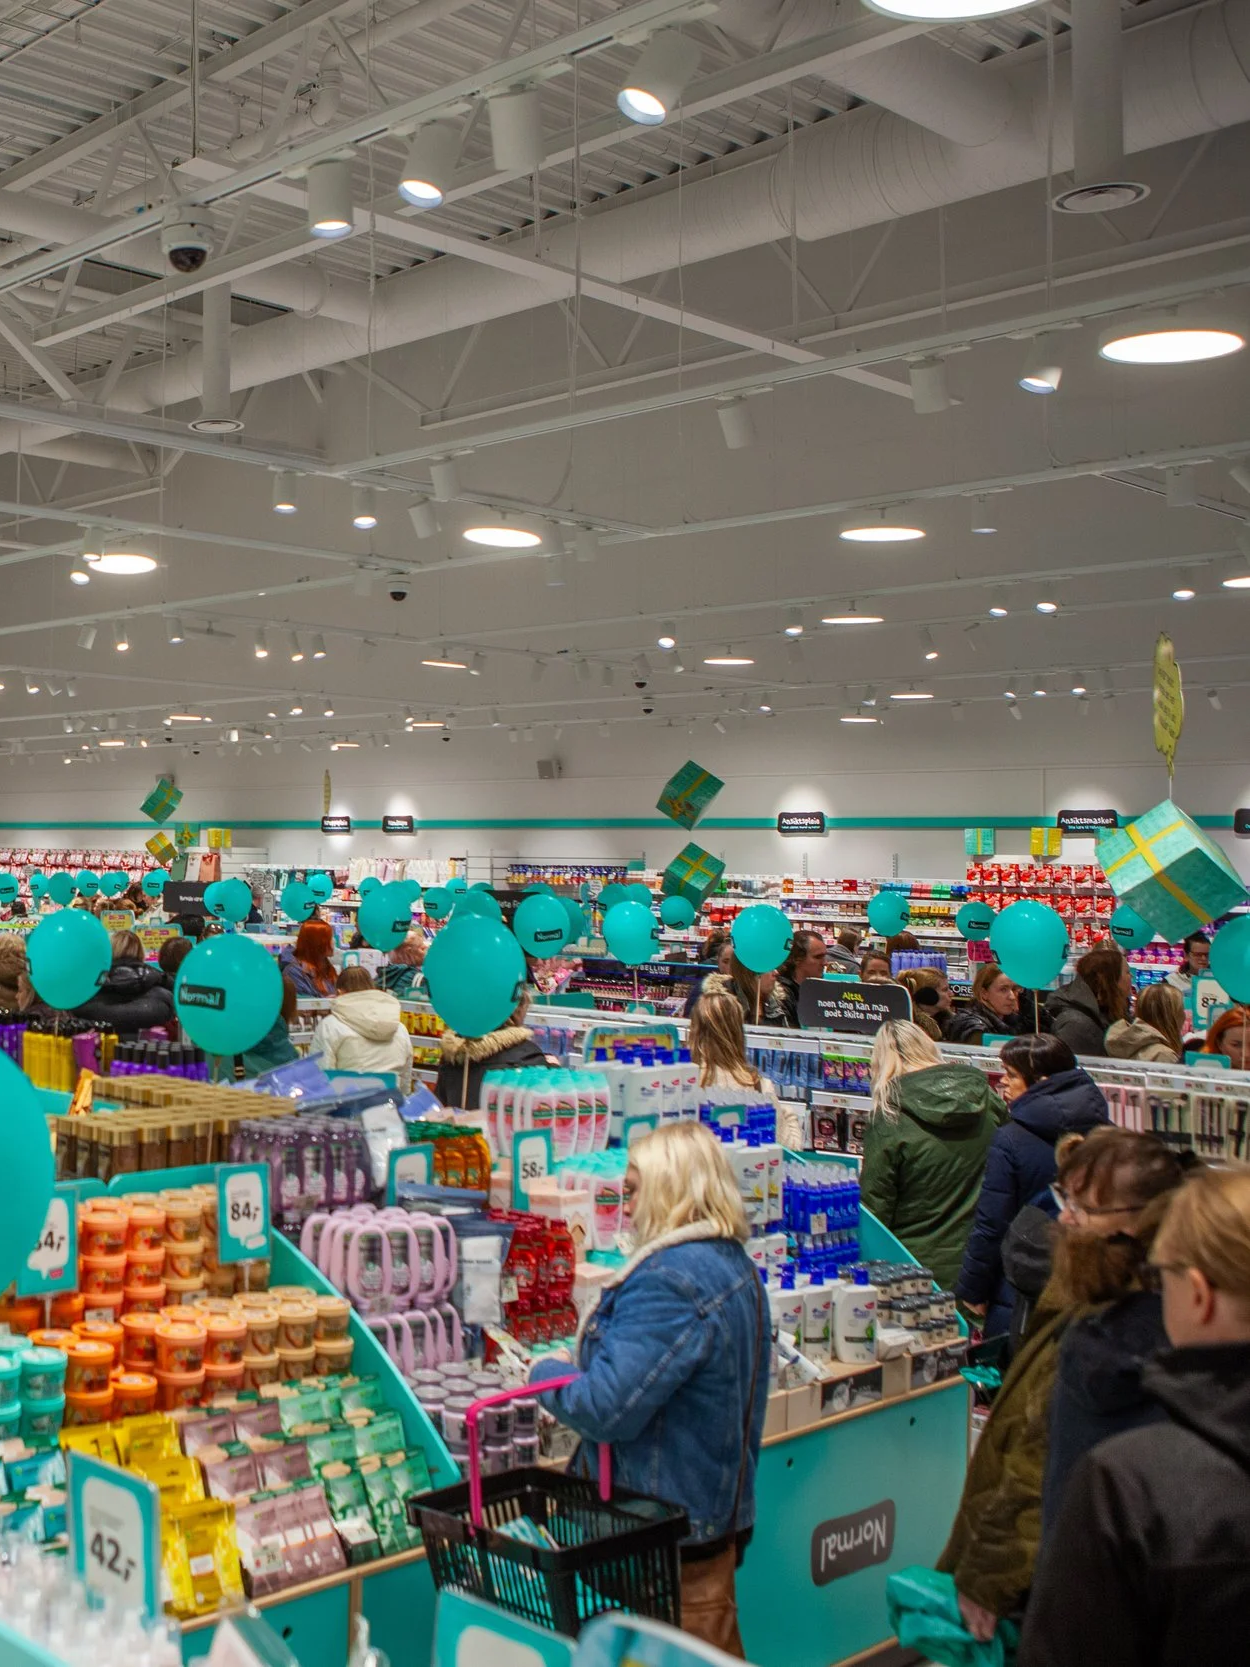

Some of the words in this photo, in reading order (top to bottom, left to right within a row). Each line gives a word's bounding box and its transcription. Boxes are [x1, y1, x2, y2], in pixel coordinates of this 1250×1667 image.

[1061, 816, 1115, 825] Ansiktsmasker
[537, 931, 561, 941] Normal
[181, 986, 221, 1007] Normal
[817, 1000, 837, 1008] noen
[838, 1000, 853, 1011] ting
[855, 1001, 871, 1010] kan
[871, 1003, 890, 1013] man
[824, 1009, 842, 1018] godt
[866, 1012, 883, 1022] med
[231, 1201, 261, 1221] 84,-
[36, 1231, 66, 1253] 4,-
[820, 1512, 887, 1573] Normal
[90, 1532, 136, 1582] 42,-
